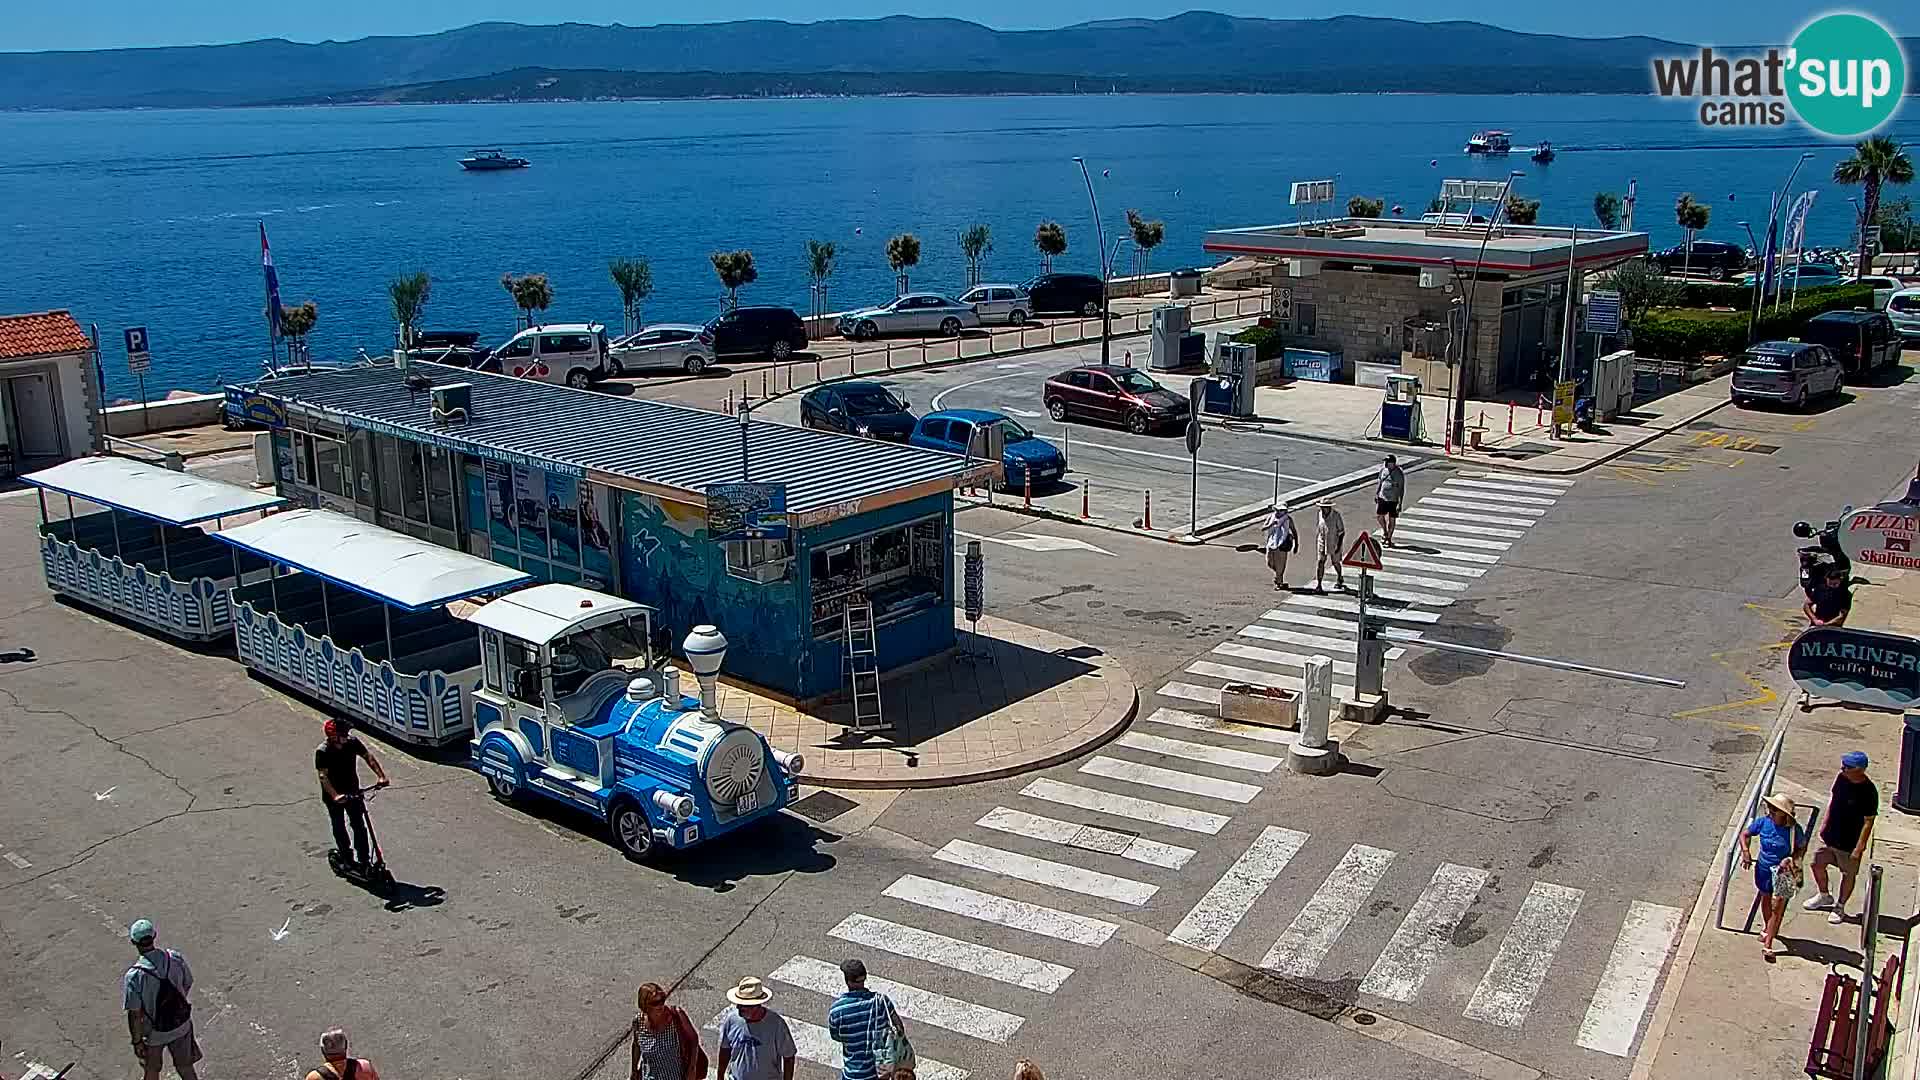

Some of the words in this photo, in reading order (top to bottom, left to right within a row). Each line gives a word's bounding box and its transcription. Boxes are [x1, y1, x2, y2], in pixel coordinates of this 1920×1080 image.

[129, 331, 142, 349] P
[478, 447, 492, 458] BUS
[494, 450, 526, 464] STATION
[527, 457, 554, 471] TICKET
[555, 463, 582, 476] OFFICE
[1848, 514, 1920, 533] PIZZE
[1829, 662, 1866, 673] caffe
[1871, 665, 1897, 679] bar
